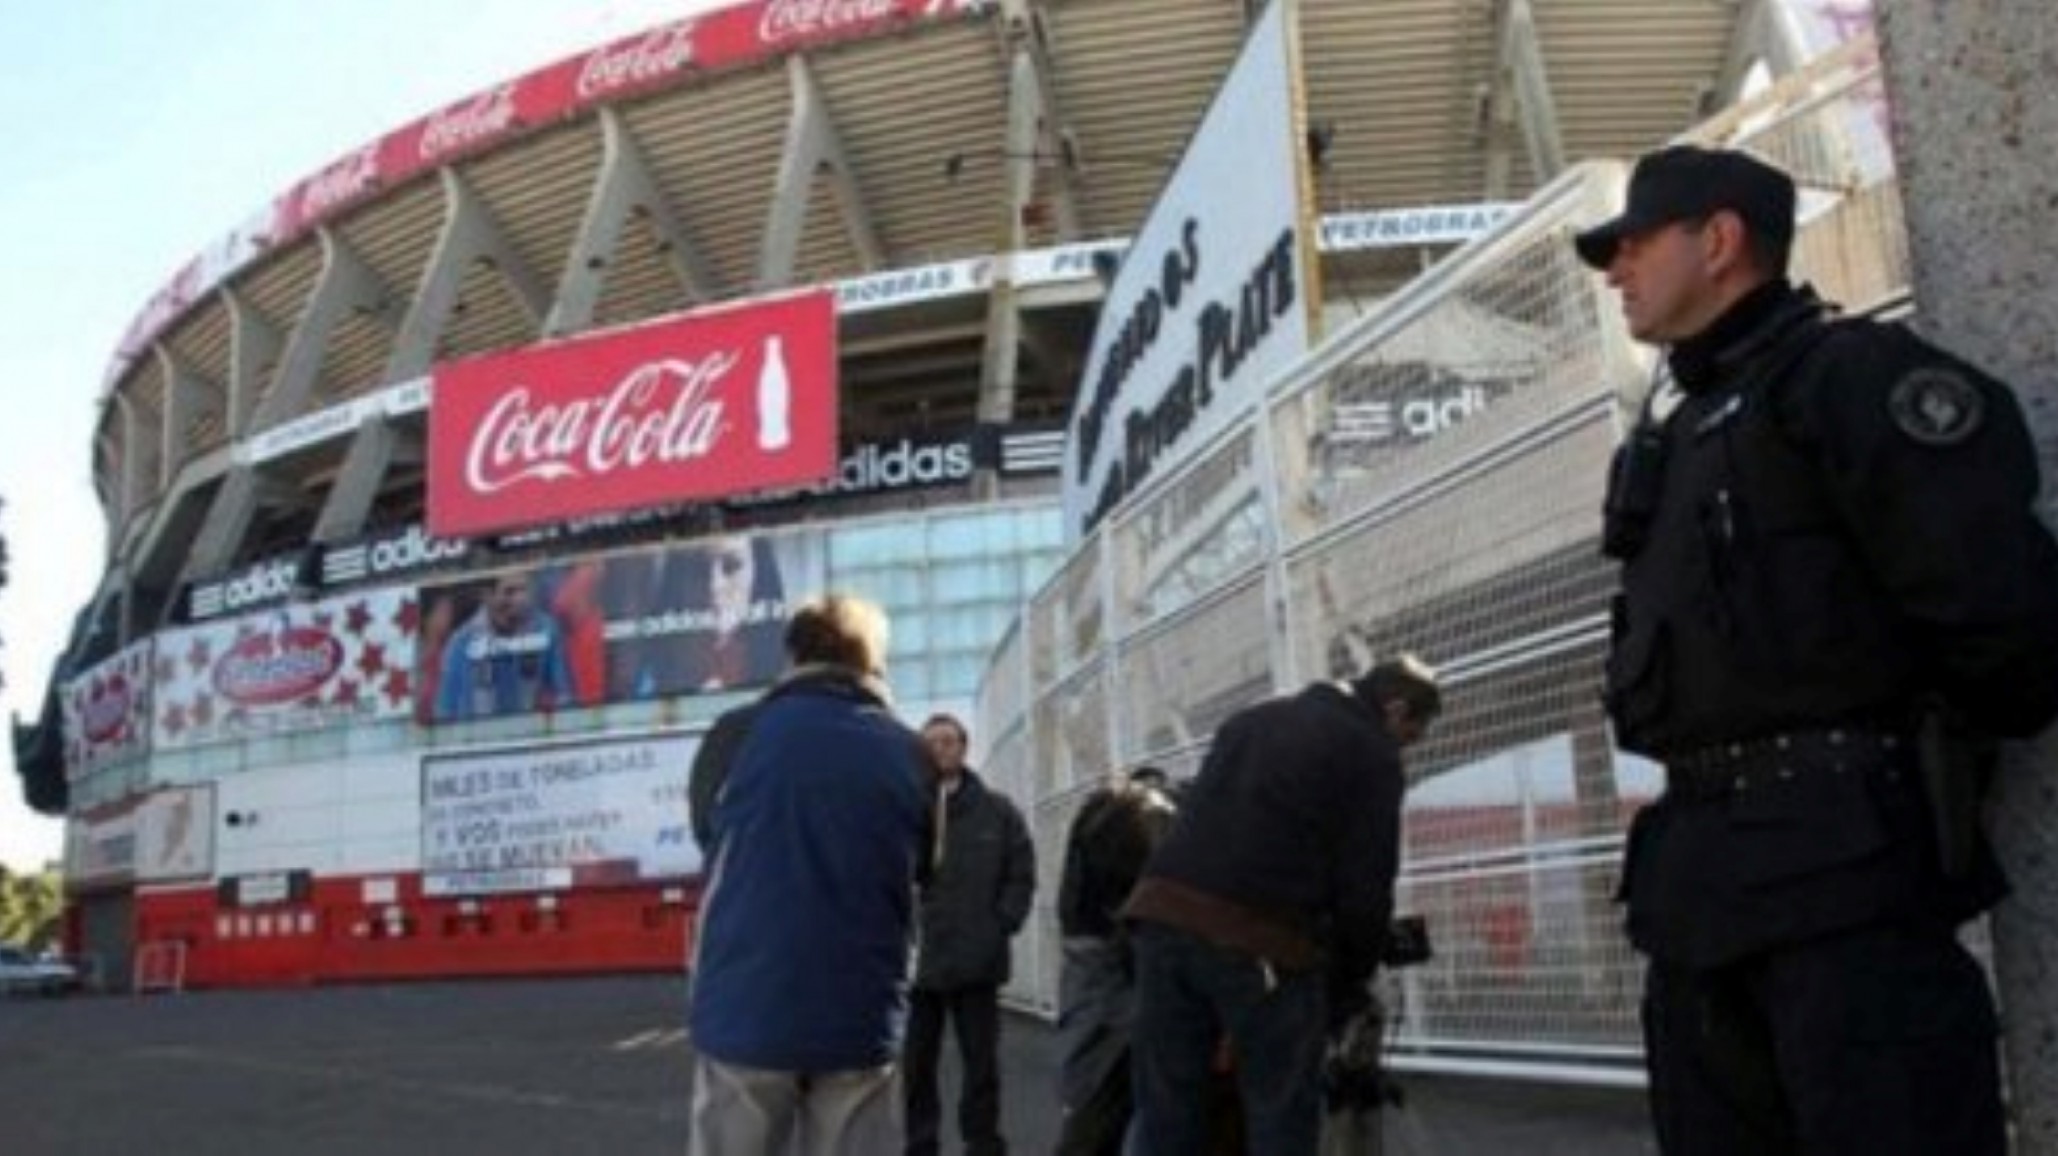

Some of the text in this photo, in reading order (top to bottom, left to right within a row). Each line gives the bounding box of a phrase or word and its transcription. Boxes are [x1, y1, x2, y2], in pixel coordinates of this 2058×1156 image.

[844, 268, 953, 301] ROBRAS
[466, 348, 741, 493] Coca-Cola
[812, 440, 972, 494] didas
